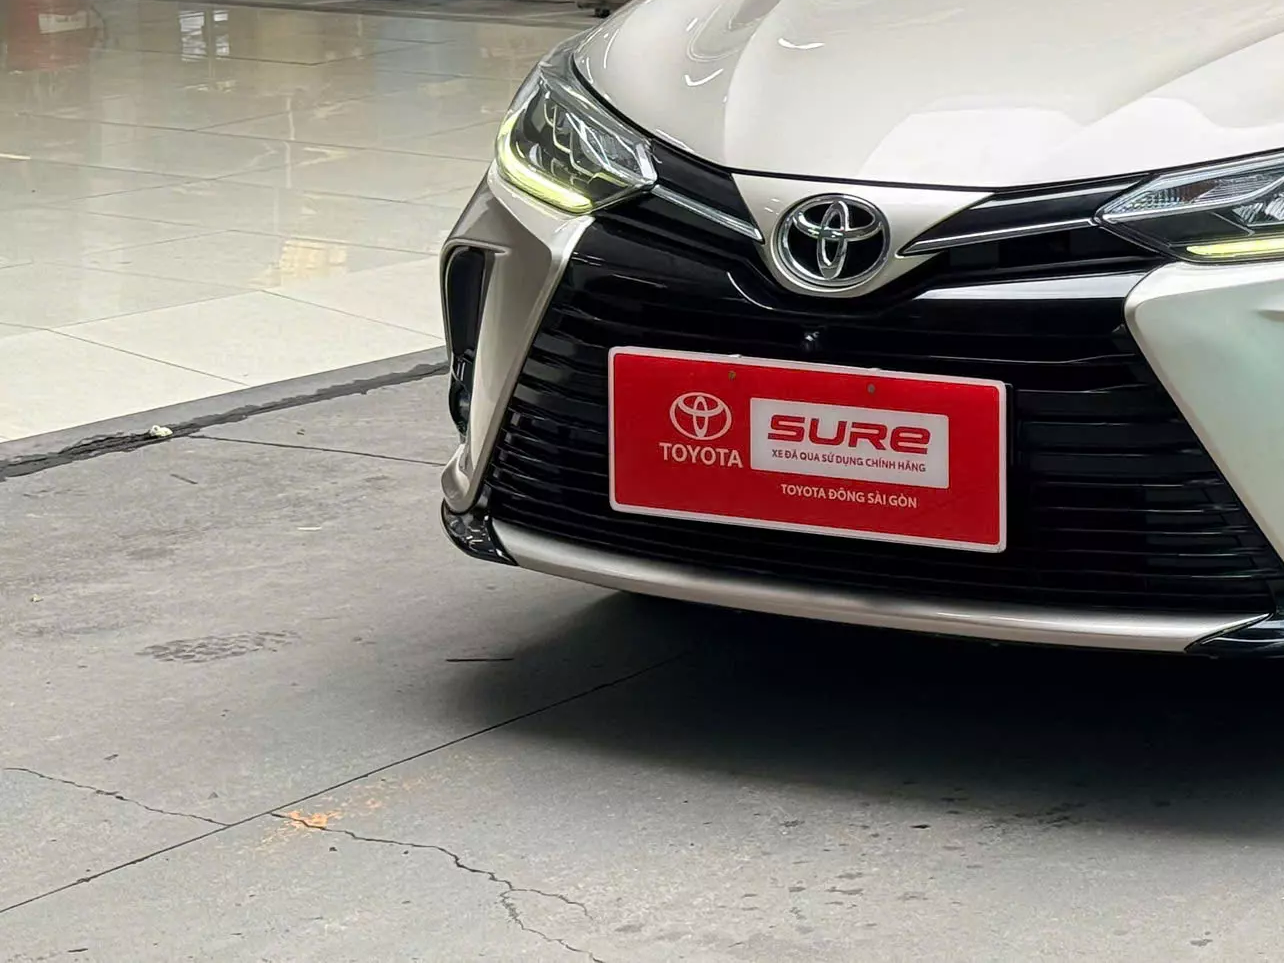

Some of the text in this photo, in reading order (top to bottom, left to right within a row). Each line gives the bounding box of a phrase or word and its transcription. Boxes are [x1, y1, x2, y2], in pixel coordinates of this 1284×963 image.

[659, 442, 744, 468] TOYOTA
[772, 449, 783, 459] XE
[800, 452, 820, 463] QUA
[836, 455, 864, 467] DỤNG
[865, 457, 896, 469] CHÍNH
[780, 483, 917, 508] TOYOTA ĐÔNG SÀI GÒN
